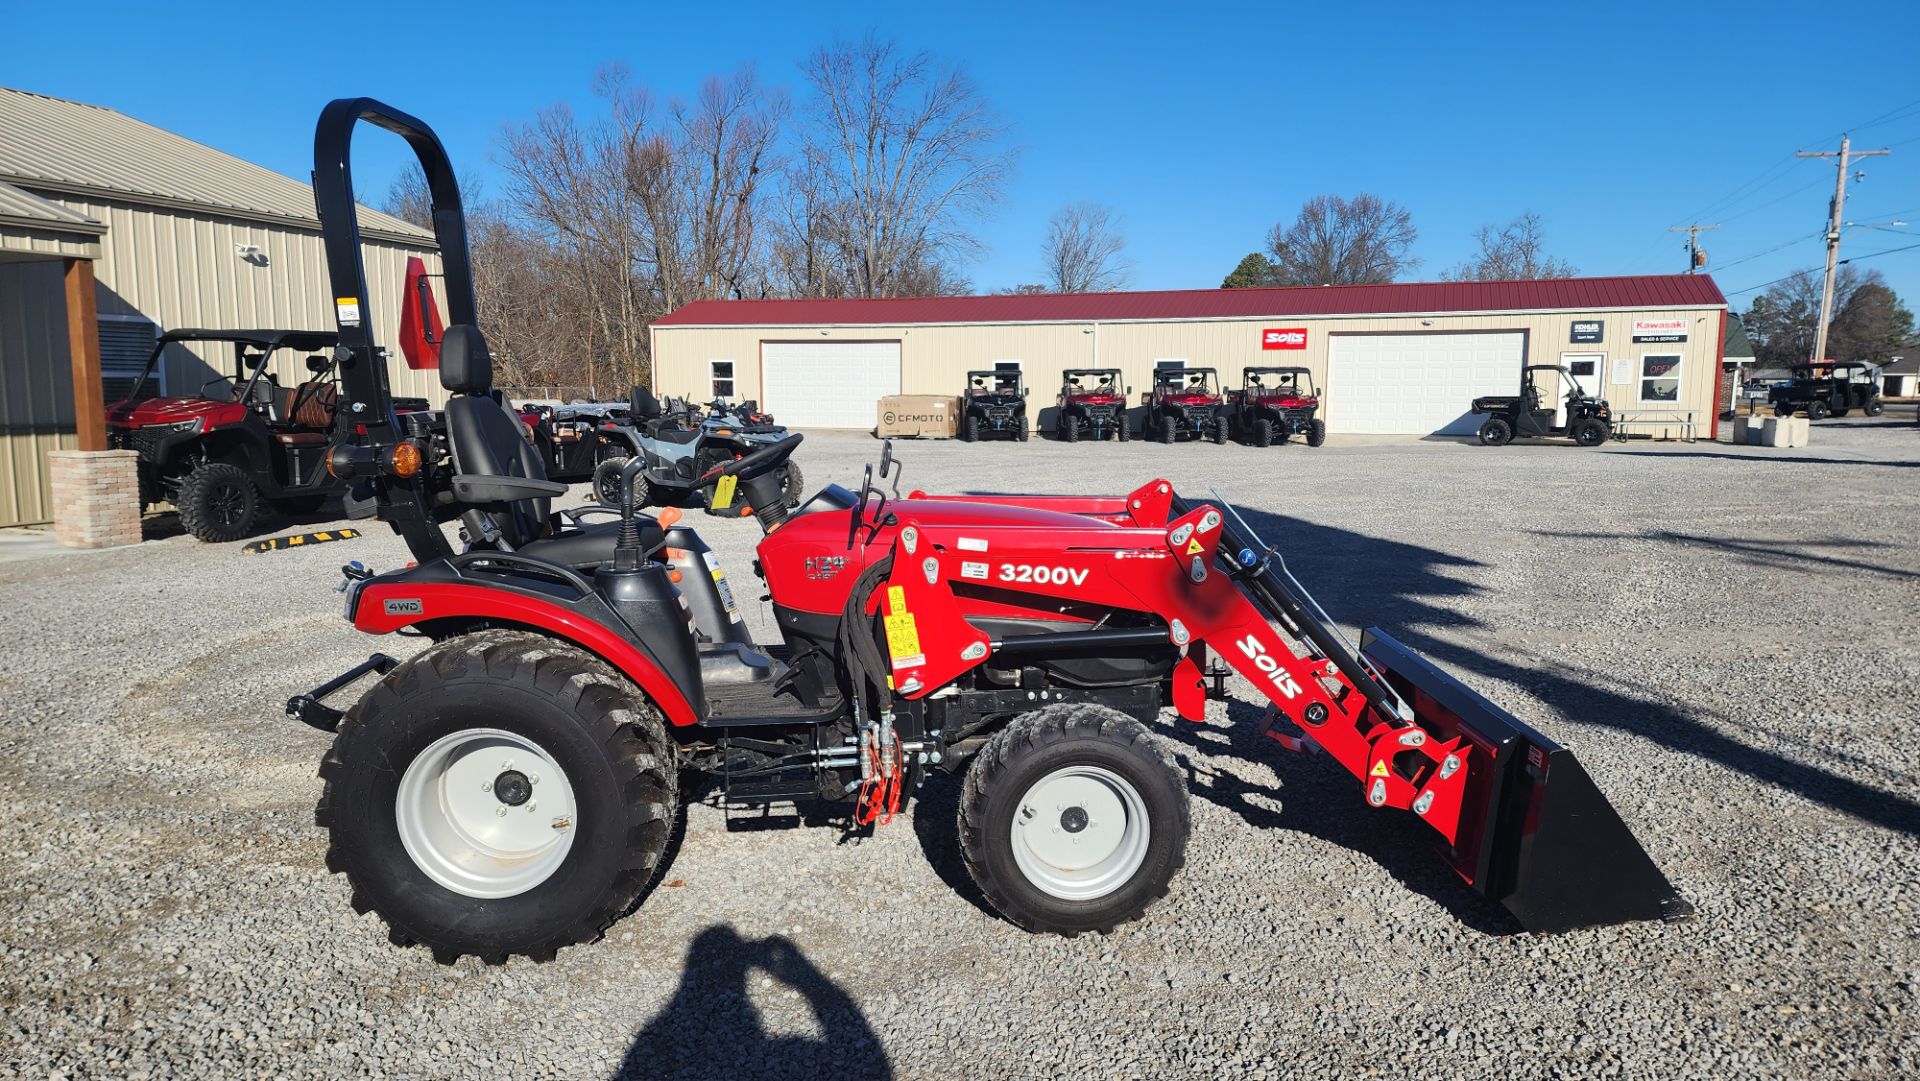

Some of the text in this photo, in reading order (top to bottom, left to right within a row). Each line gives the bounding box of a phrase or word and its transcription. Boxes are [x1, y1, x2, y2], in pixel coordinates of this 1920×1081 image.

[1636, 321, 1686, 329] Kawasaki
[1265, 332, 1305, 343] Solis
[1650, 363, 1673, 375] OPEN
[898, 414, 944, 422] CFMOTO
[999, 563, 1089, 586] 3200V
[389, 602, 418, 611] 4WD
[1236, 634, 1303, 699] Solis
